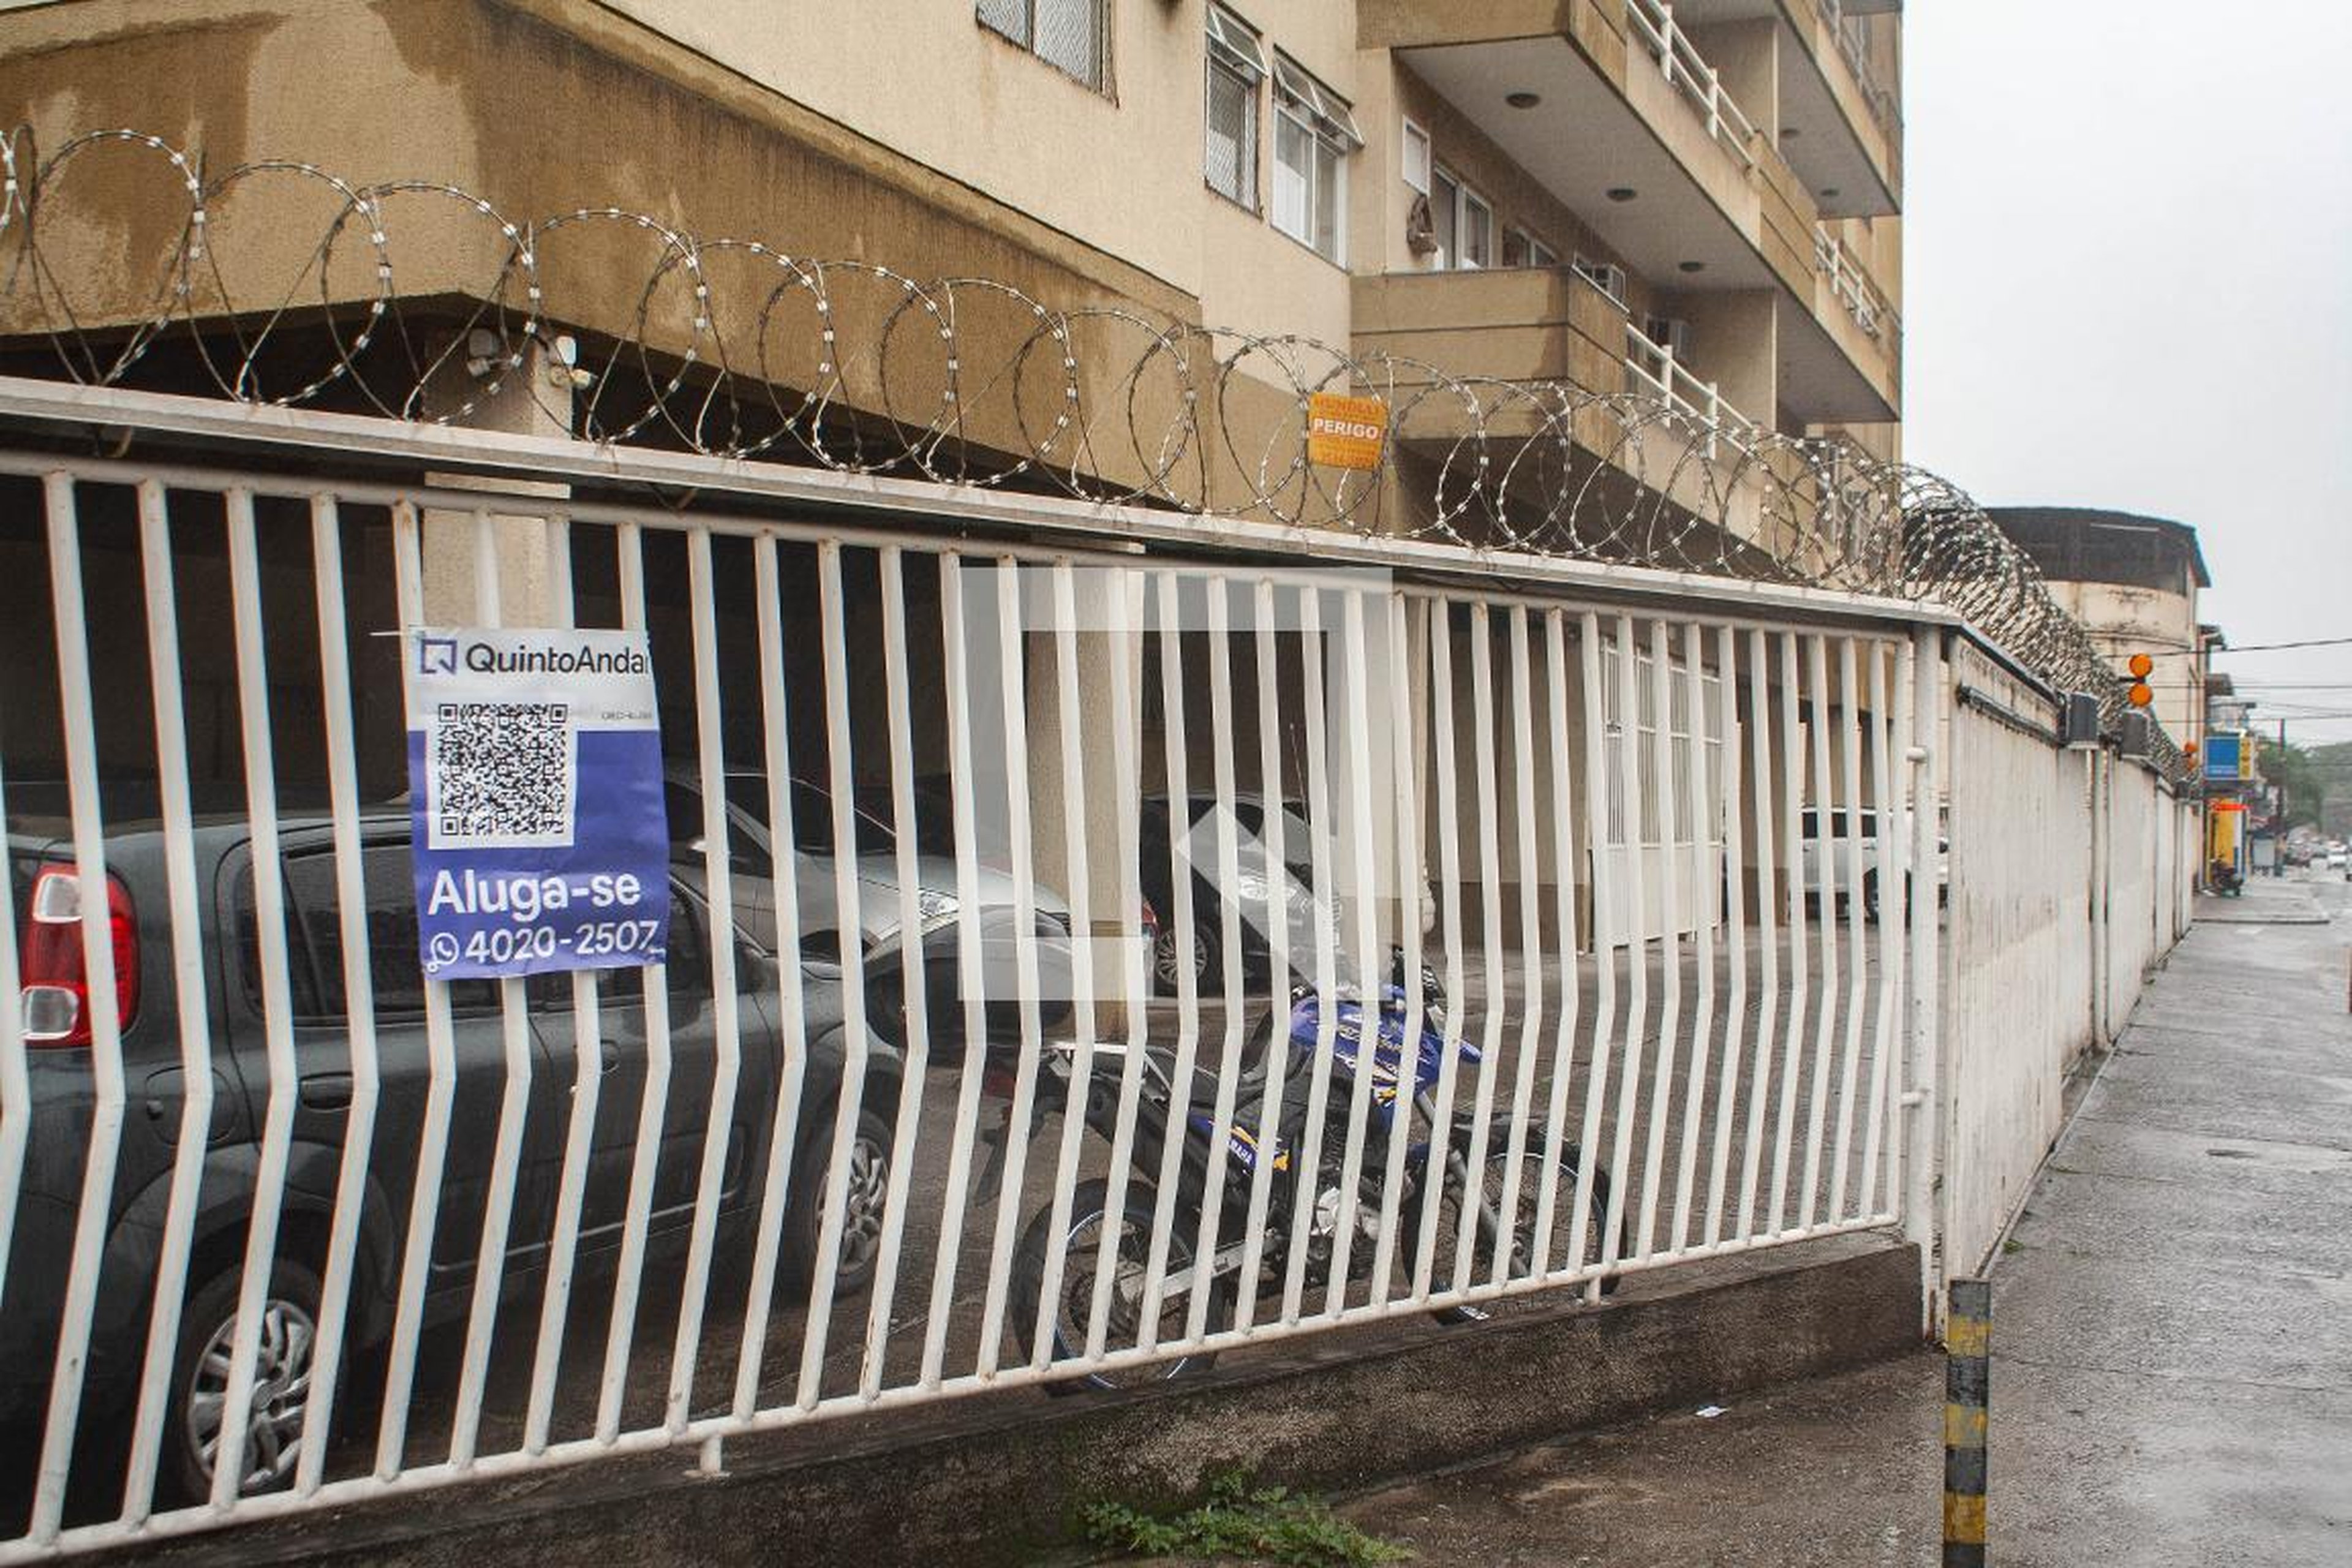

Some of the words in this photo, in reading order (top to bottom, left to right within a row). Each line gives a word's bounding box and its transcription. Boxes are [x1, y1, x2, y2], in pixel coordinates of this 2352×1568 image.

[1314, 418, 1379, 440] PERIGO
[465, 642, 648, 675] QuintoAnda
[428, 869, 641, 922] Aluga-se
[465, 921, 659, 963] 4020-2507
